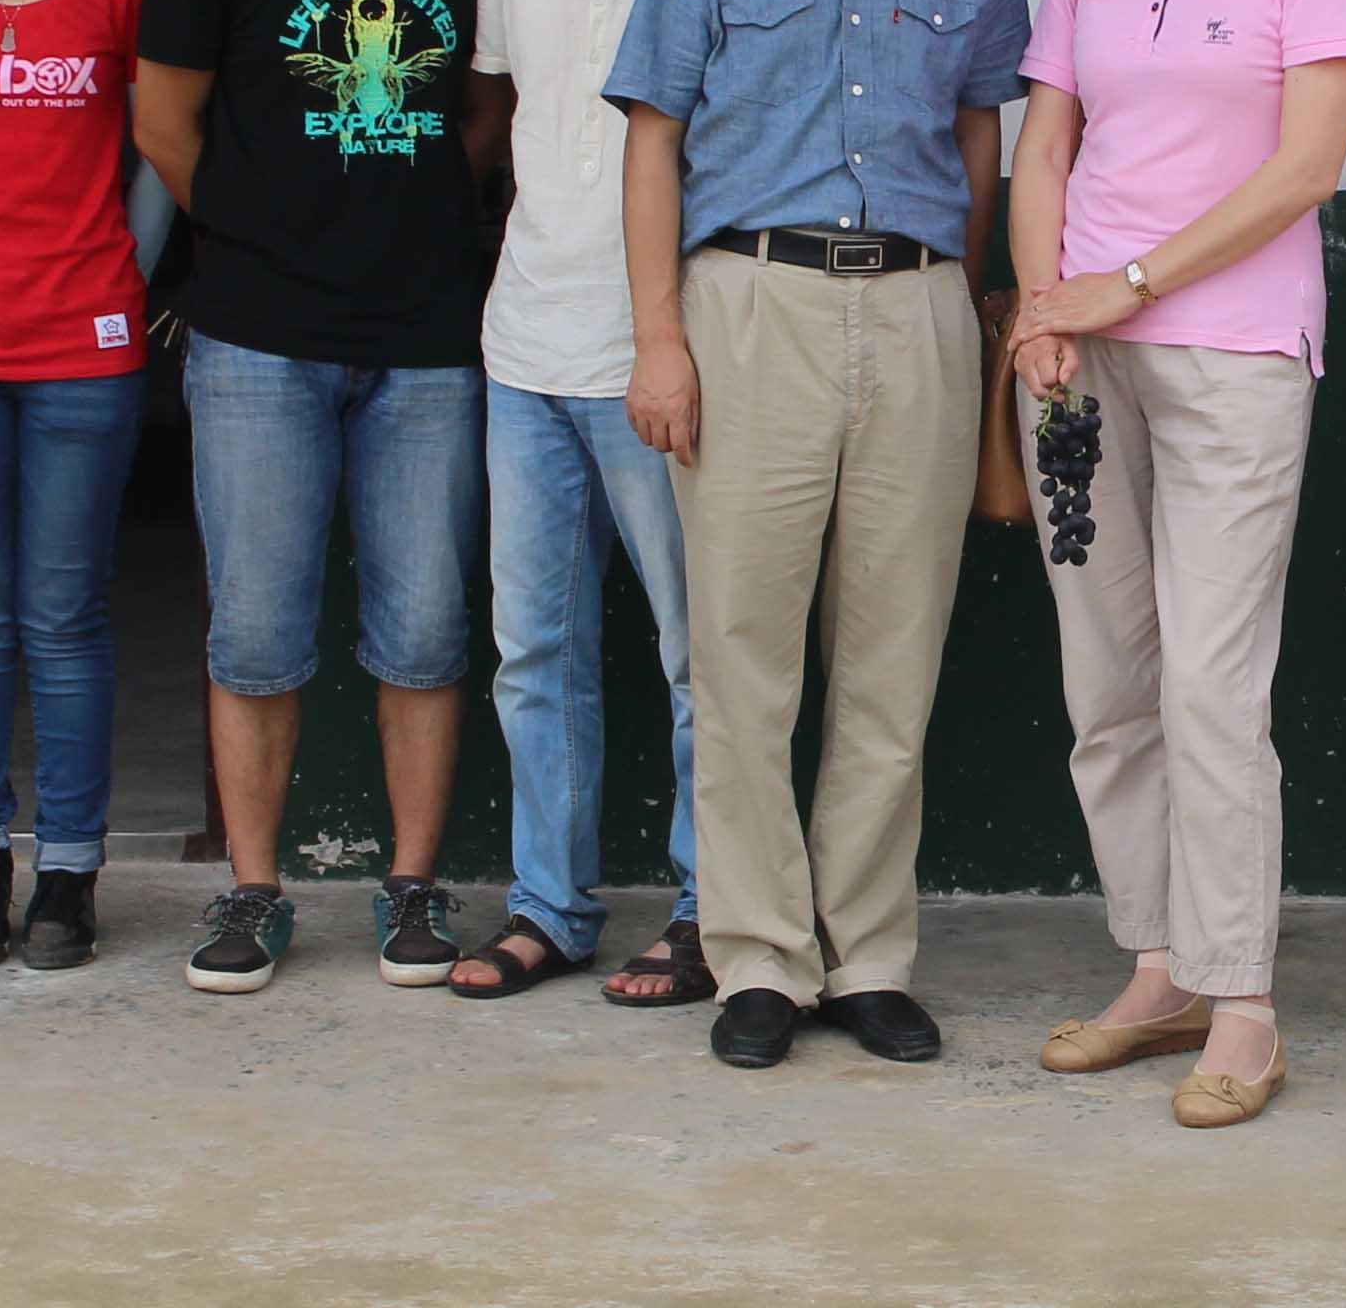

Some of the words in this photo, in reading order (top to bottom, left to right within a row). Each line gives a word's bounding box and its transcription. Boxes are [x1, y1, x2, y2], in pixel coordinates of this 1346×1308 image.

[1, 98, 25, 107] OUT
[26, 98, 40, 107] OF
[43, 98, 63, 108] THE
[65, 98, 86, 108] BOX
[304, 111, 443, 138] EXPLORE
[339, 138, 416, 155] NATURE
